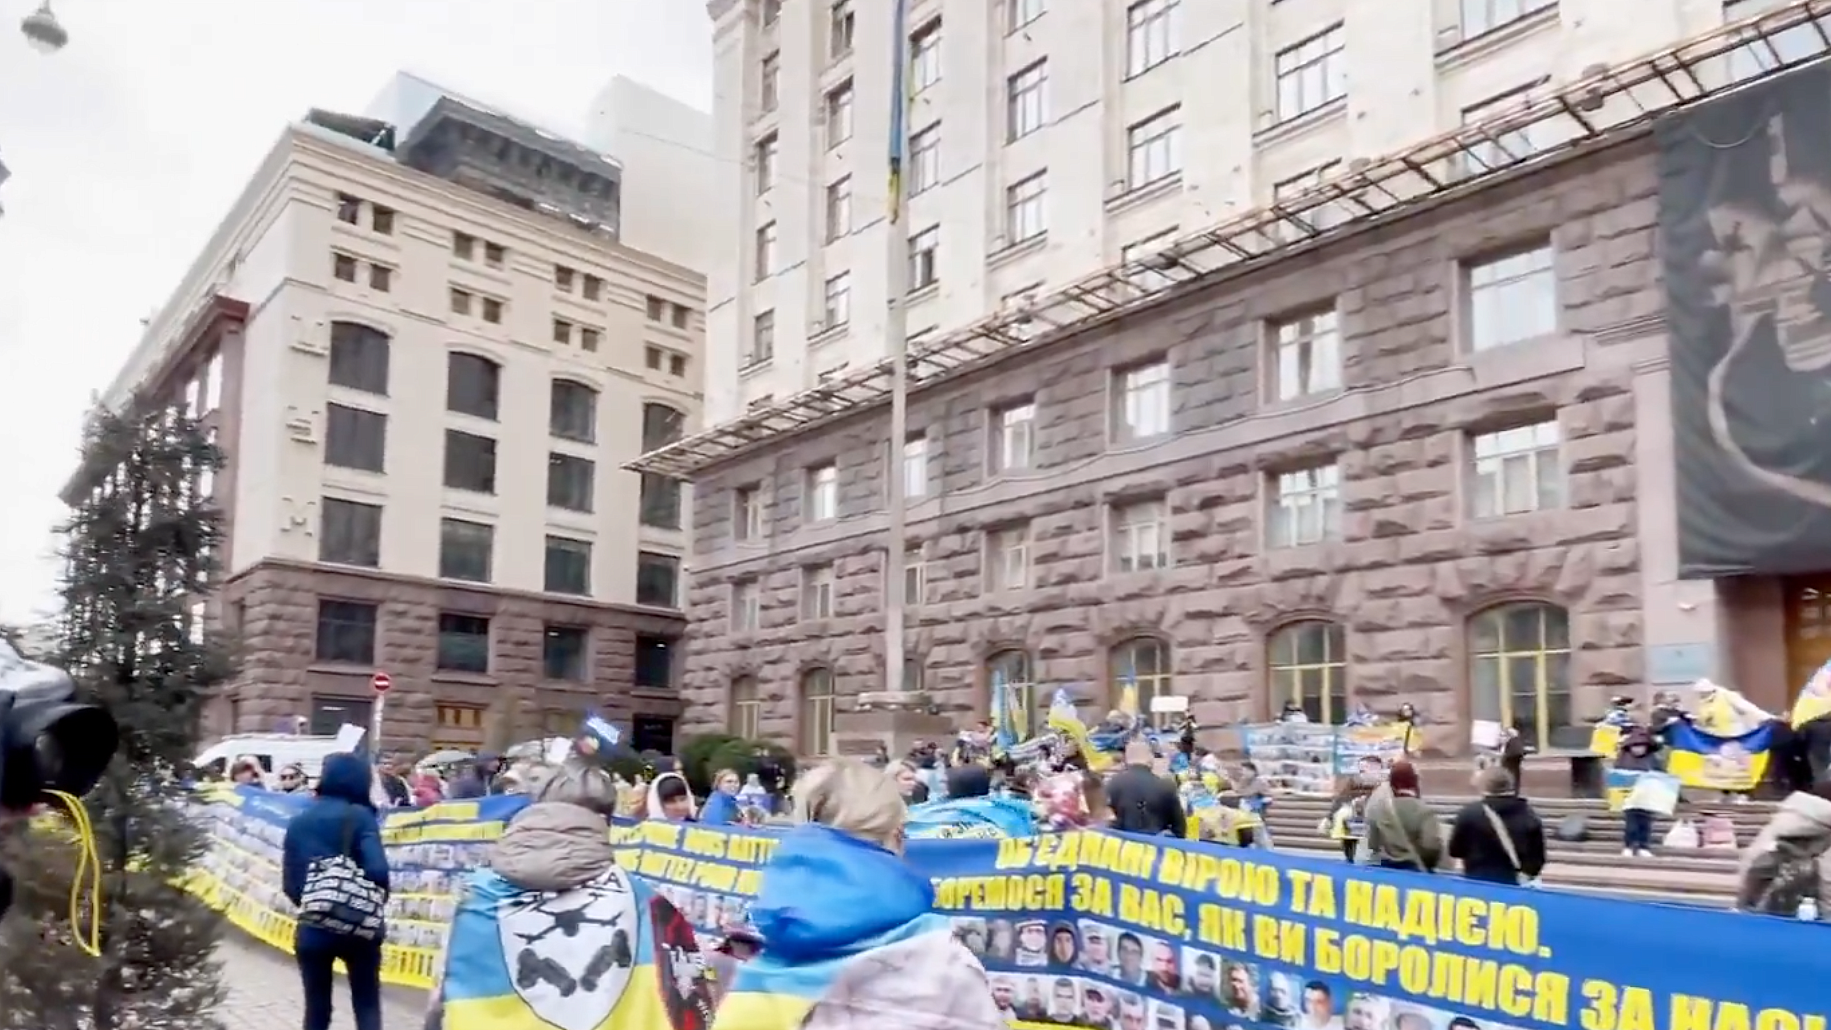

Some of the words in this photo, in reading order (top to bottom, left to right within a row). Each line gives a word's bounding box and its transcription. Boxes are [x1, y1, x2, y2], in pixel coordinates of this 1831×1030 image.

[1070, 872, 1113, 916] ЗА
[1118, 882, 1191, 939] ВАС,
[1198, 902, 1247, 951] ЯК
[1253, 913, 1307, 964] ВИ
[1314, 927, 1570, 1026] БОРОЛИСЯ
[1580, 979, 1656, 1030] ЗА
[1158, 847, 1281, 906] ВІРОЮ
[1288, 869, 1336, 919] ТА
[1344, 879, 1552, 958] НАДІЄЮ.
